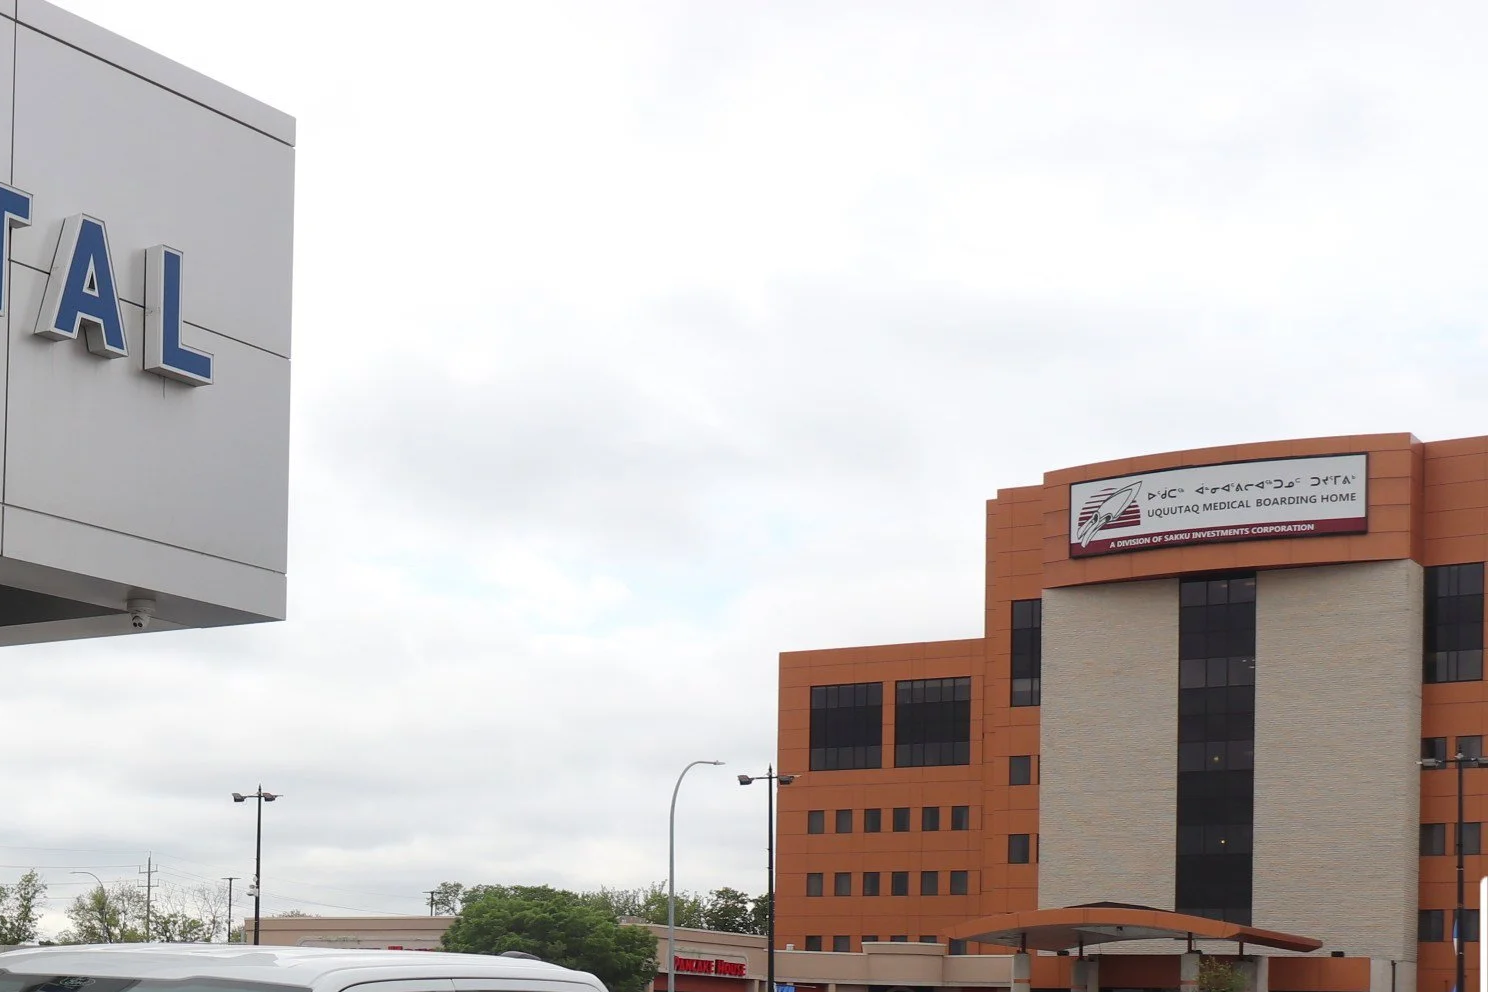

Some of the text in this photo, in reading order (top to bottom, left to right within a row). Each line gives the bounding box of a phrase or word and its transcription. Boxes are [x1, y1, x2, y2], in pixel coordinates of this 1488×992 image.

[1147, 492, 1357, 518] UQUUTAQ MEDICAL BOARDING HOME
[1109, 523, 1315, 549] A DIVISION OF SAKKU INVESTMENTS CORPORATION
